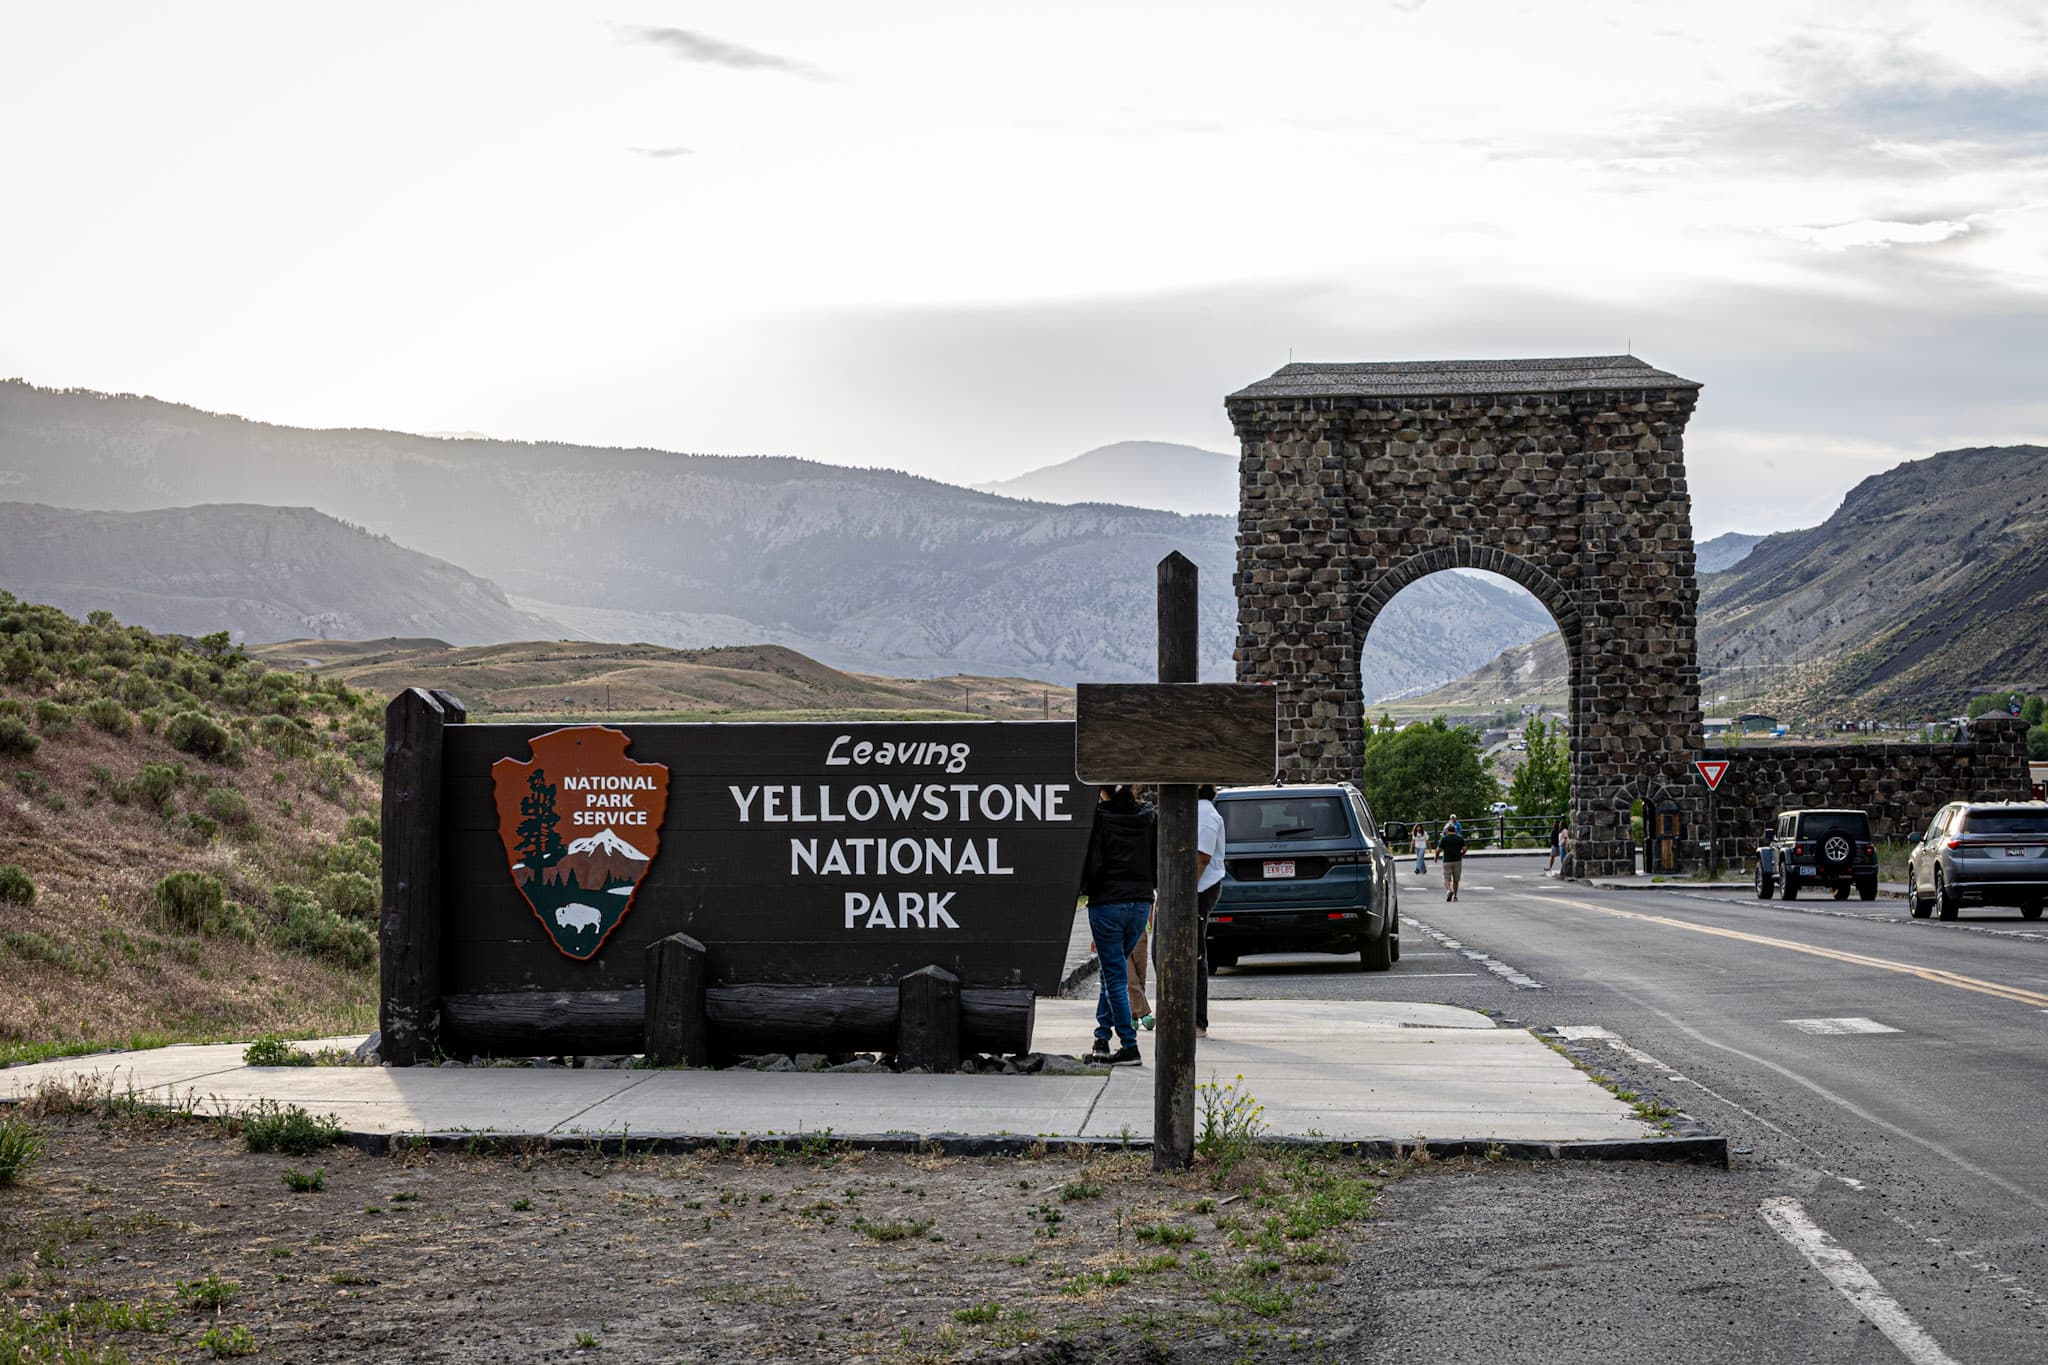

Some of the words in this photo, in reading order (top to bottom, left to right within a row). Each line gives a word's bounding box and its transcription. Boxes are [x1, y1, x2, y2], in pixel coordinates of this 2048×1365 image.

[825, 735, 971, 774] Leaving
[563, 776, 658, 791] NATIONAL
[586, 793, 635, 808] PARK
[573, 811, 648, 826] SERVICE
[728, 783, 1073, 823] YELLOWSTONE
[790, 837, 1014, 875] NATIONAL
[844, 891, 960, 929] PARK
